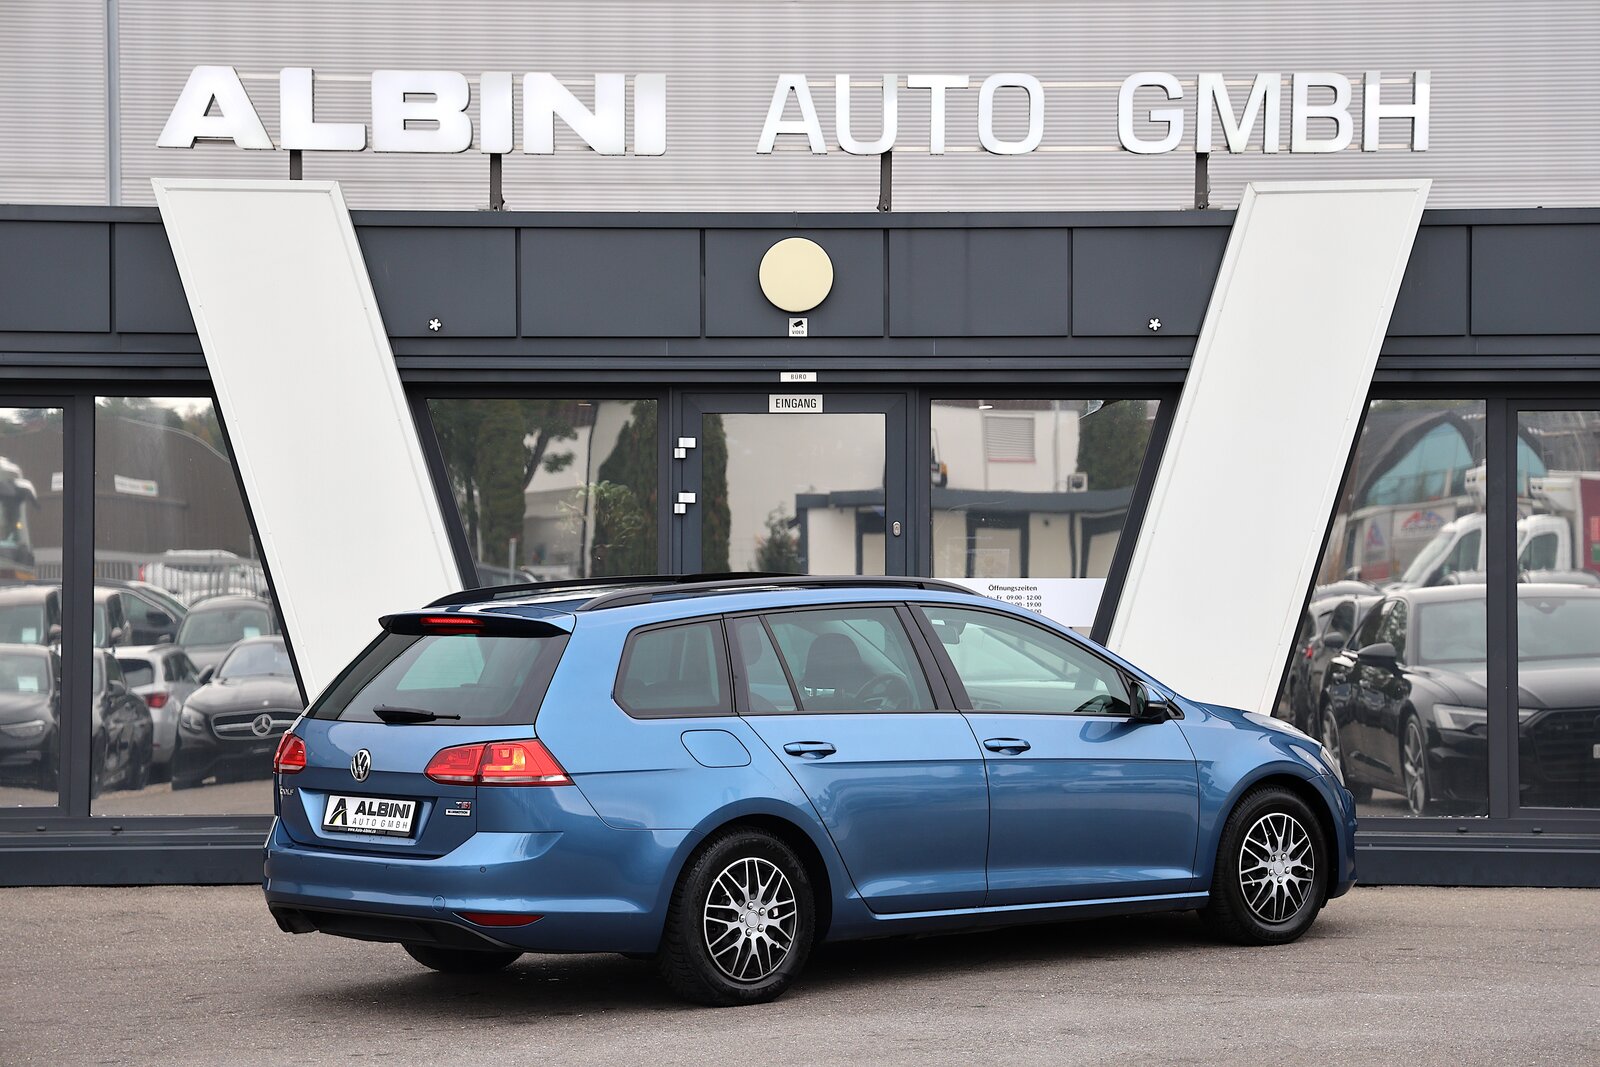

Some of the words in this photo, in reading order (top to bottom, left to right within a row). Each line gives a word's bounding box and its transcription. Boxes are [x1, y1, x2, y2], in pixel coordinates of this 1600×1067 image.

[156, 65, 666, 156] ALBINI
[756, 73, 1045, 155] AUTO
[1117, 70, 1431, 155] GMBH
[776, 398, 816, 408] EINGANG
[354, 800, 411, 818] ALBINI
[352, 818, 376, 827] AUTO
[380, 820, 408, 828] GMBH
